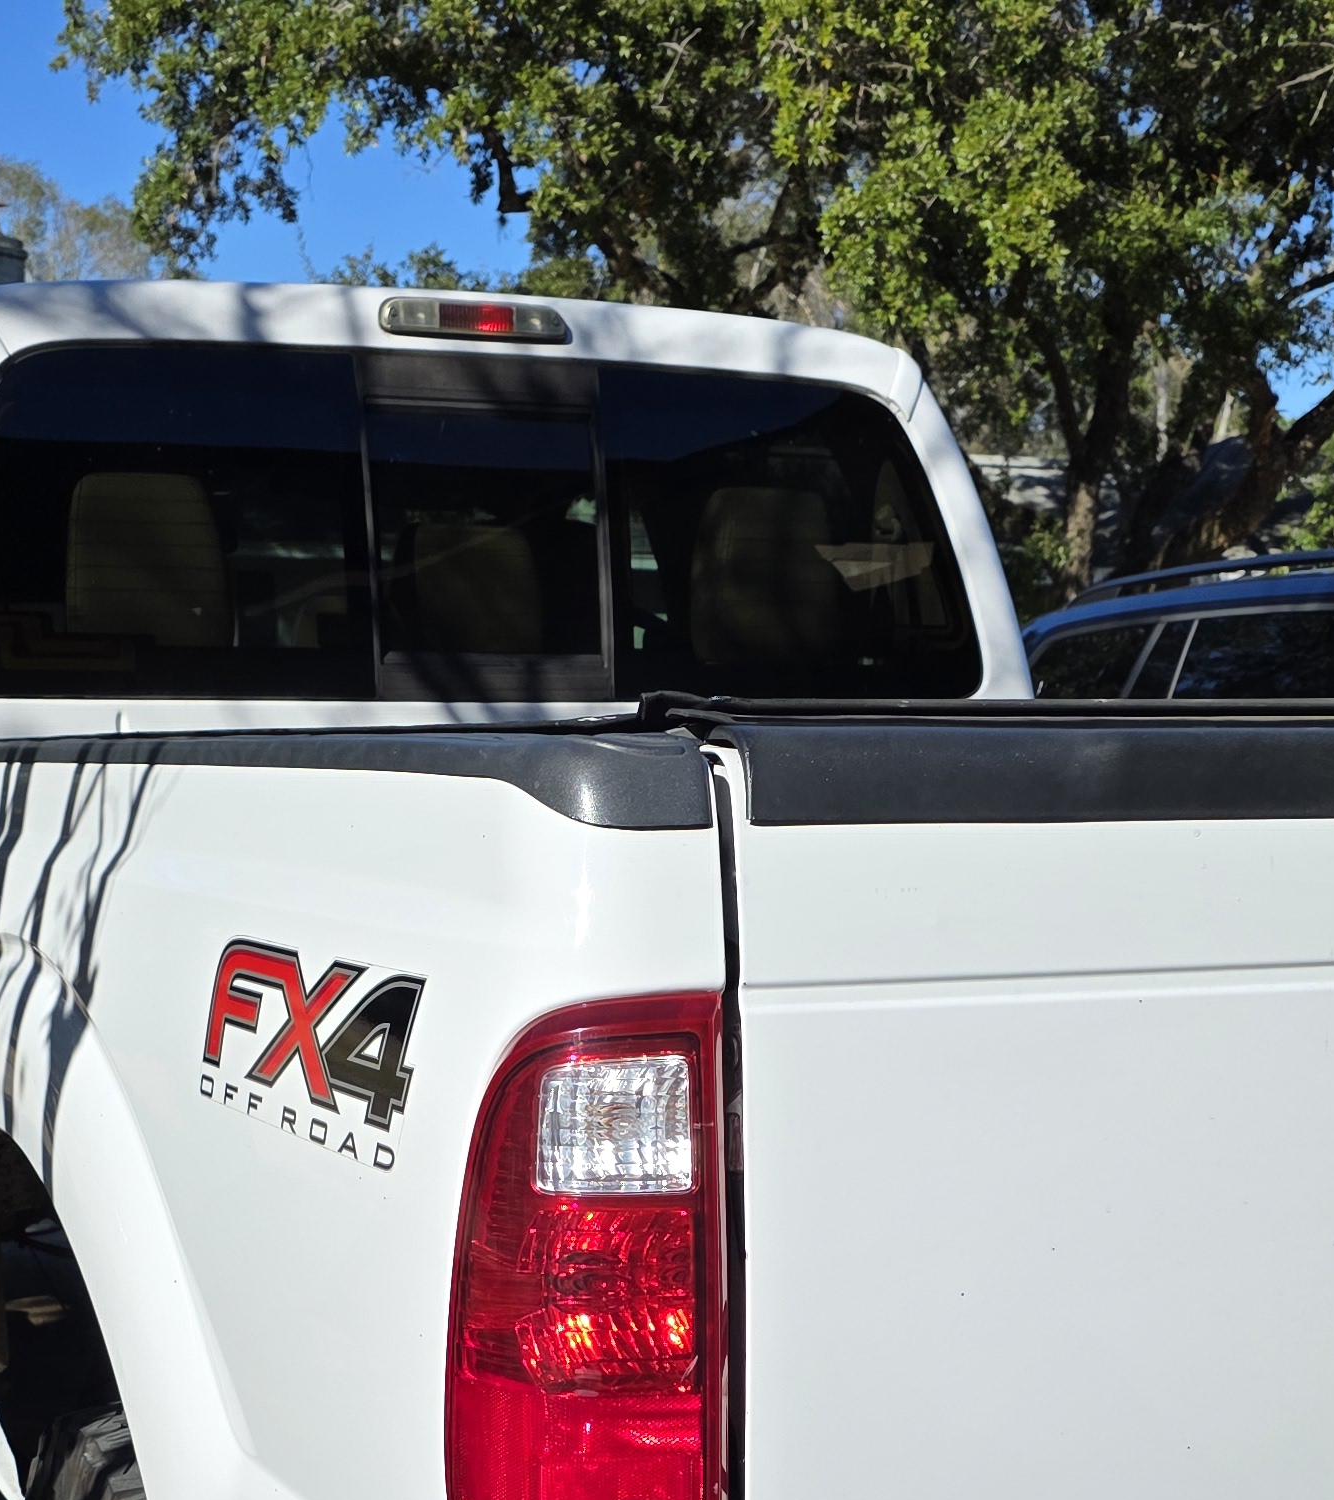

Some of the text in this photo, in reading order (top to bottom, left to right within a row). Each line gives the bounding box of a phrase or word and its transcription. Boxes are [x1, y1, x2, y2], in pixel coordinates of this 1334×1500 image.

[203, 937, 427, 1132] FX4
[200, 1073, 396, 1171] OFF ROAD
